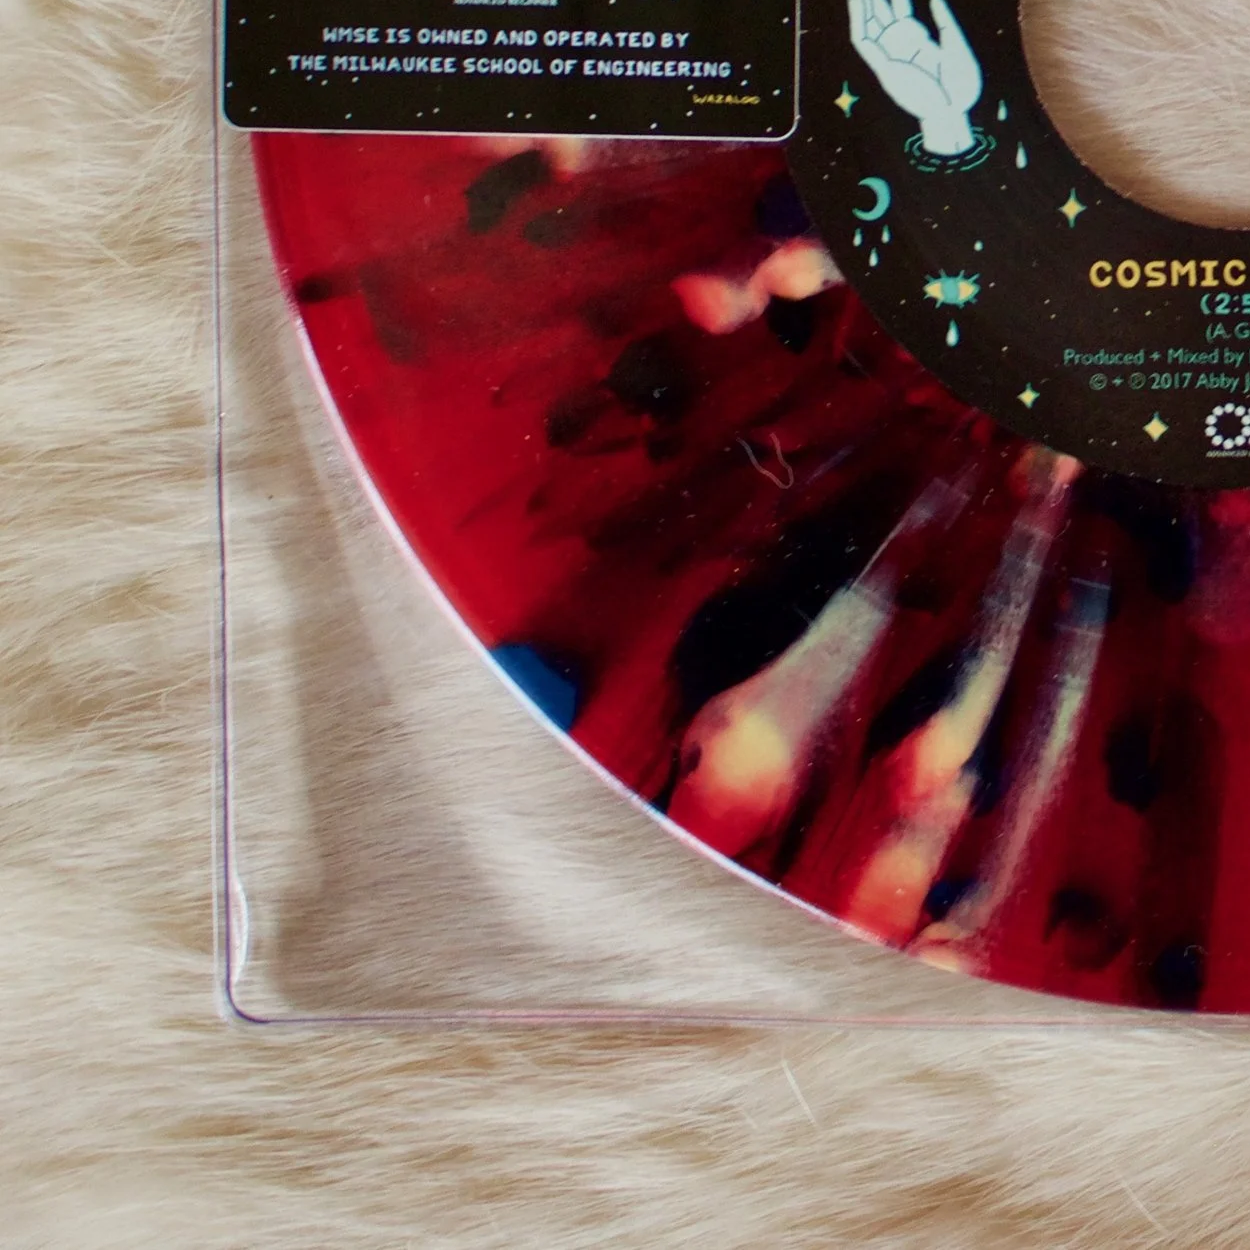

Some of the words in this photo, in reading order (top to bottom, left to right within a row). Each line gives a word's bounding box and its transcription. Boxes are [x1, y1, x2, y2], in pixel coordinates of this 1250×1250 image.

[322, 27, 380, 44] WMSE
[384, 27, 411, 44] IS
[416, 27, 489, 46] OWNED
[493, 29, 538, 47] AND
[542, 29, 656, 49] OPERATED
[660, 32, 690, 49] BY
[287, 54, 327, 71] THE
[332, 55, 457, 74] MILWAUKEE
[462, 57, 544, 75] SCHOOL
[549, 58, 578, 76] OF
[582, 59, 732, 78] ENGINEERING
[1088, 259, 1247, 289] COSMIC
[1063, 347, 1145, 366] Produced
[1167, 348, 1219, 364] Mixed
[1223, 348, 1245, 368] by
[1149, 372, 1193, 390] 2017
[1195, 372, 1240, 393] Abby
